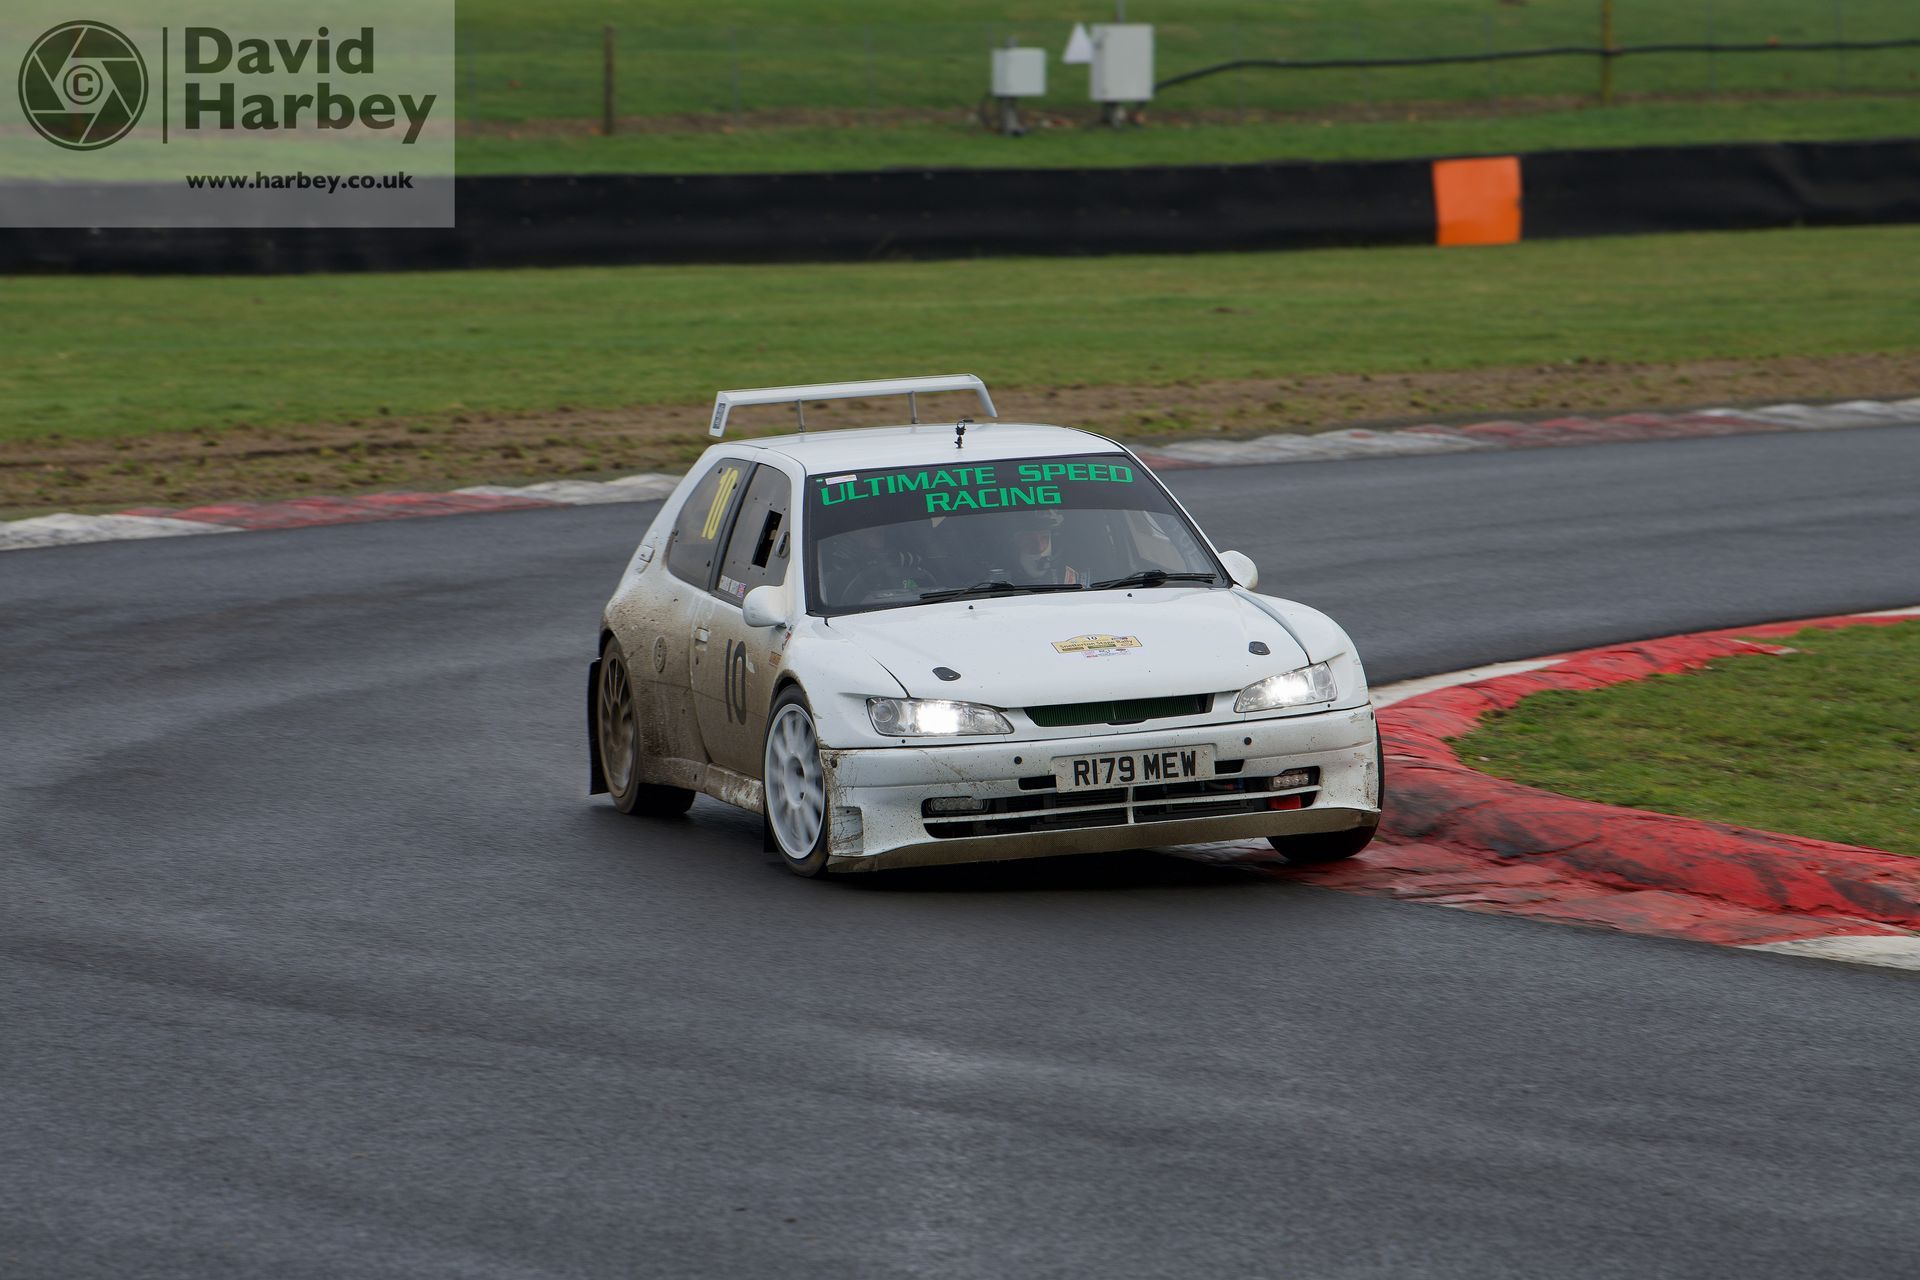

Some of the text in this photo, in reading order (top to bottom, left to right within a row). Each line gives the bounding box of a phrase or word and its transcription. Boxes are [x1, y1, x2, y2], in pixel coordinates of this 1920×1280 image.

[701, 467, 738, 540] 10
[820, 463, 1134, 506] ULTIMATE SPEED
[925, 485, 1062, 513] RACING
[725, 638, 747, 725] 10
[1073, 750, 1197, 787] R179 MEW
